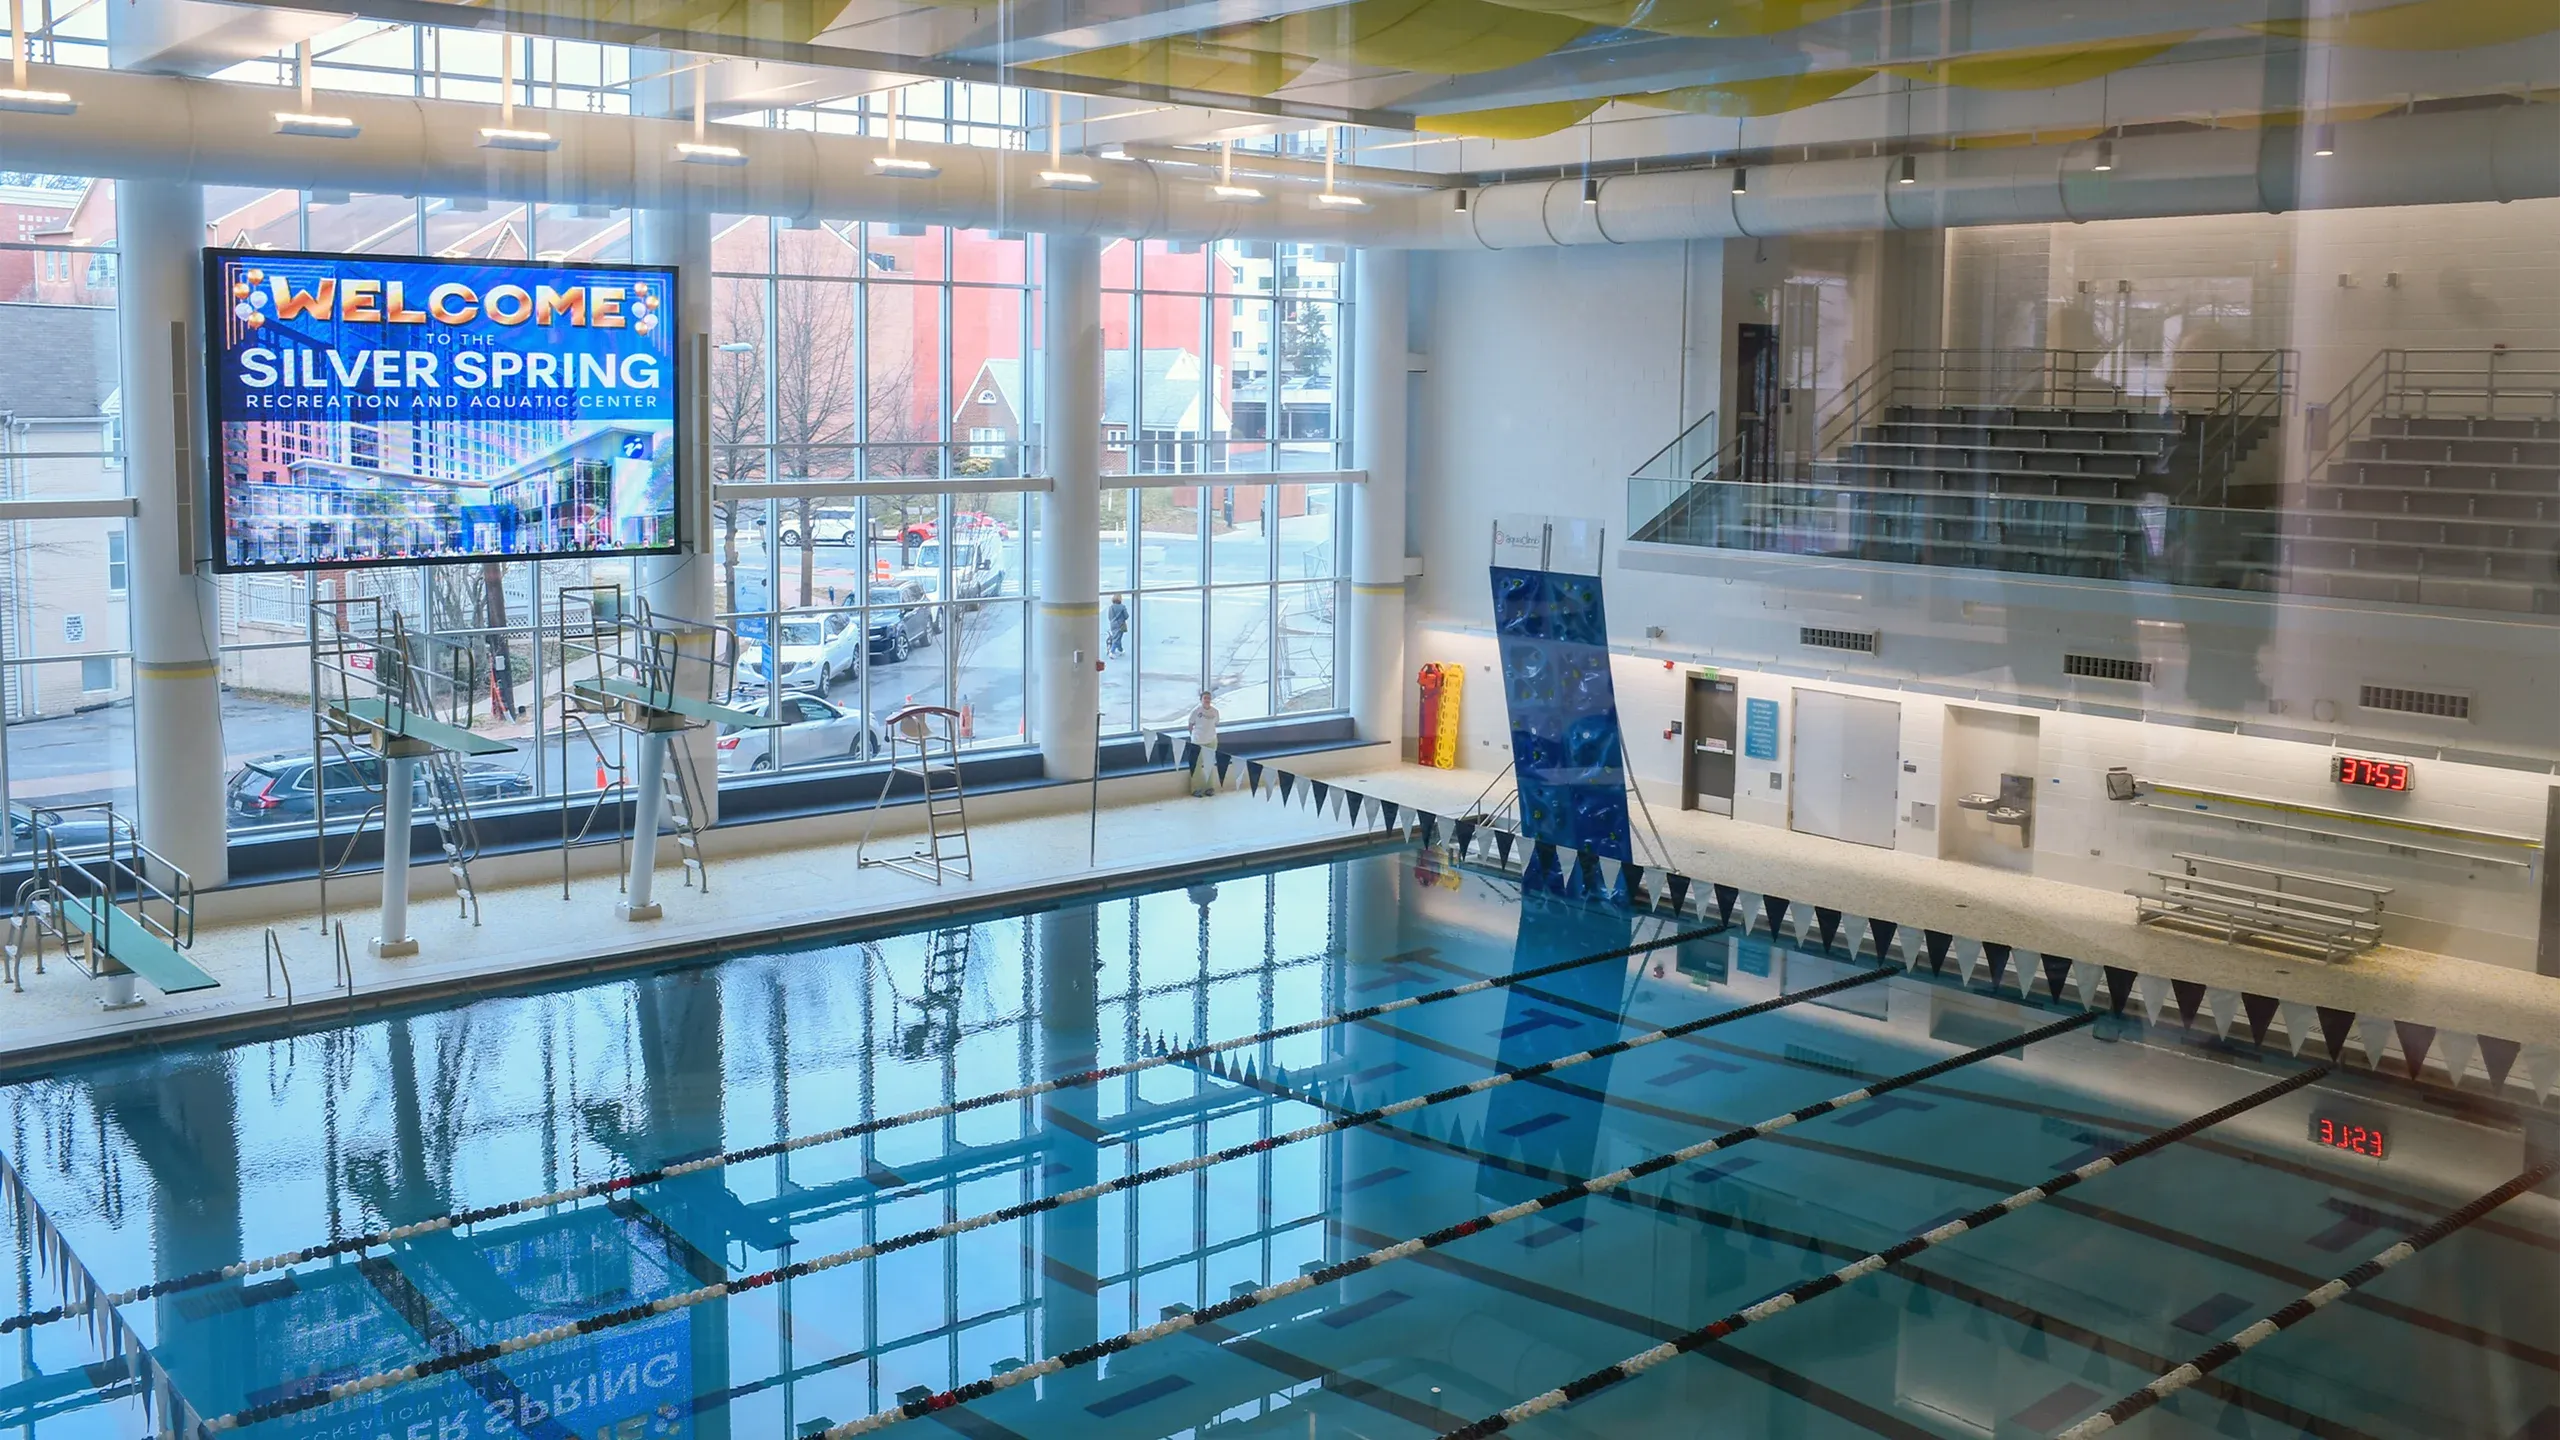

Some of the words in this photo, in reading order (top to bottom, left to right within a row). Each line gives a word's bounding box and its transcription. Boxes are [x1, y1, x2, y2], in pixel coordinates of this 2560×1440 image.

[269, 276, 626, 328] WELCOME
[426, 333, 451, 345] TO
[461, 334, 495, 346] THE
[239, 347, 441, 388] SILVER
[452, 351, 660, 389] SPRING
[246, 394, 399, 408] RECREATION
[411, 394, 458, 408] AND
[470, 395, 568, 409] AQUATIC
[579, 395, 657, 408] CENTER
[2341, 757, 2407, 791] 37:53
